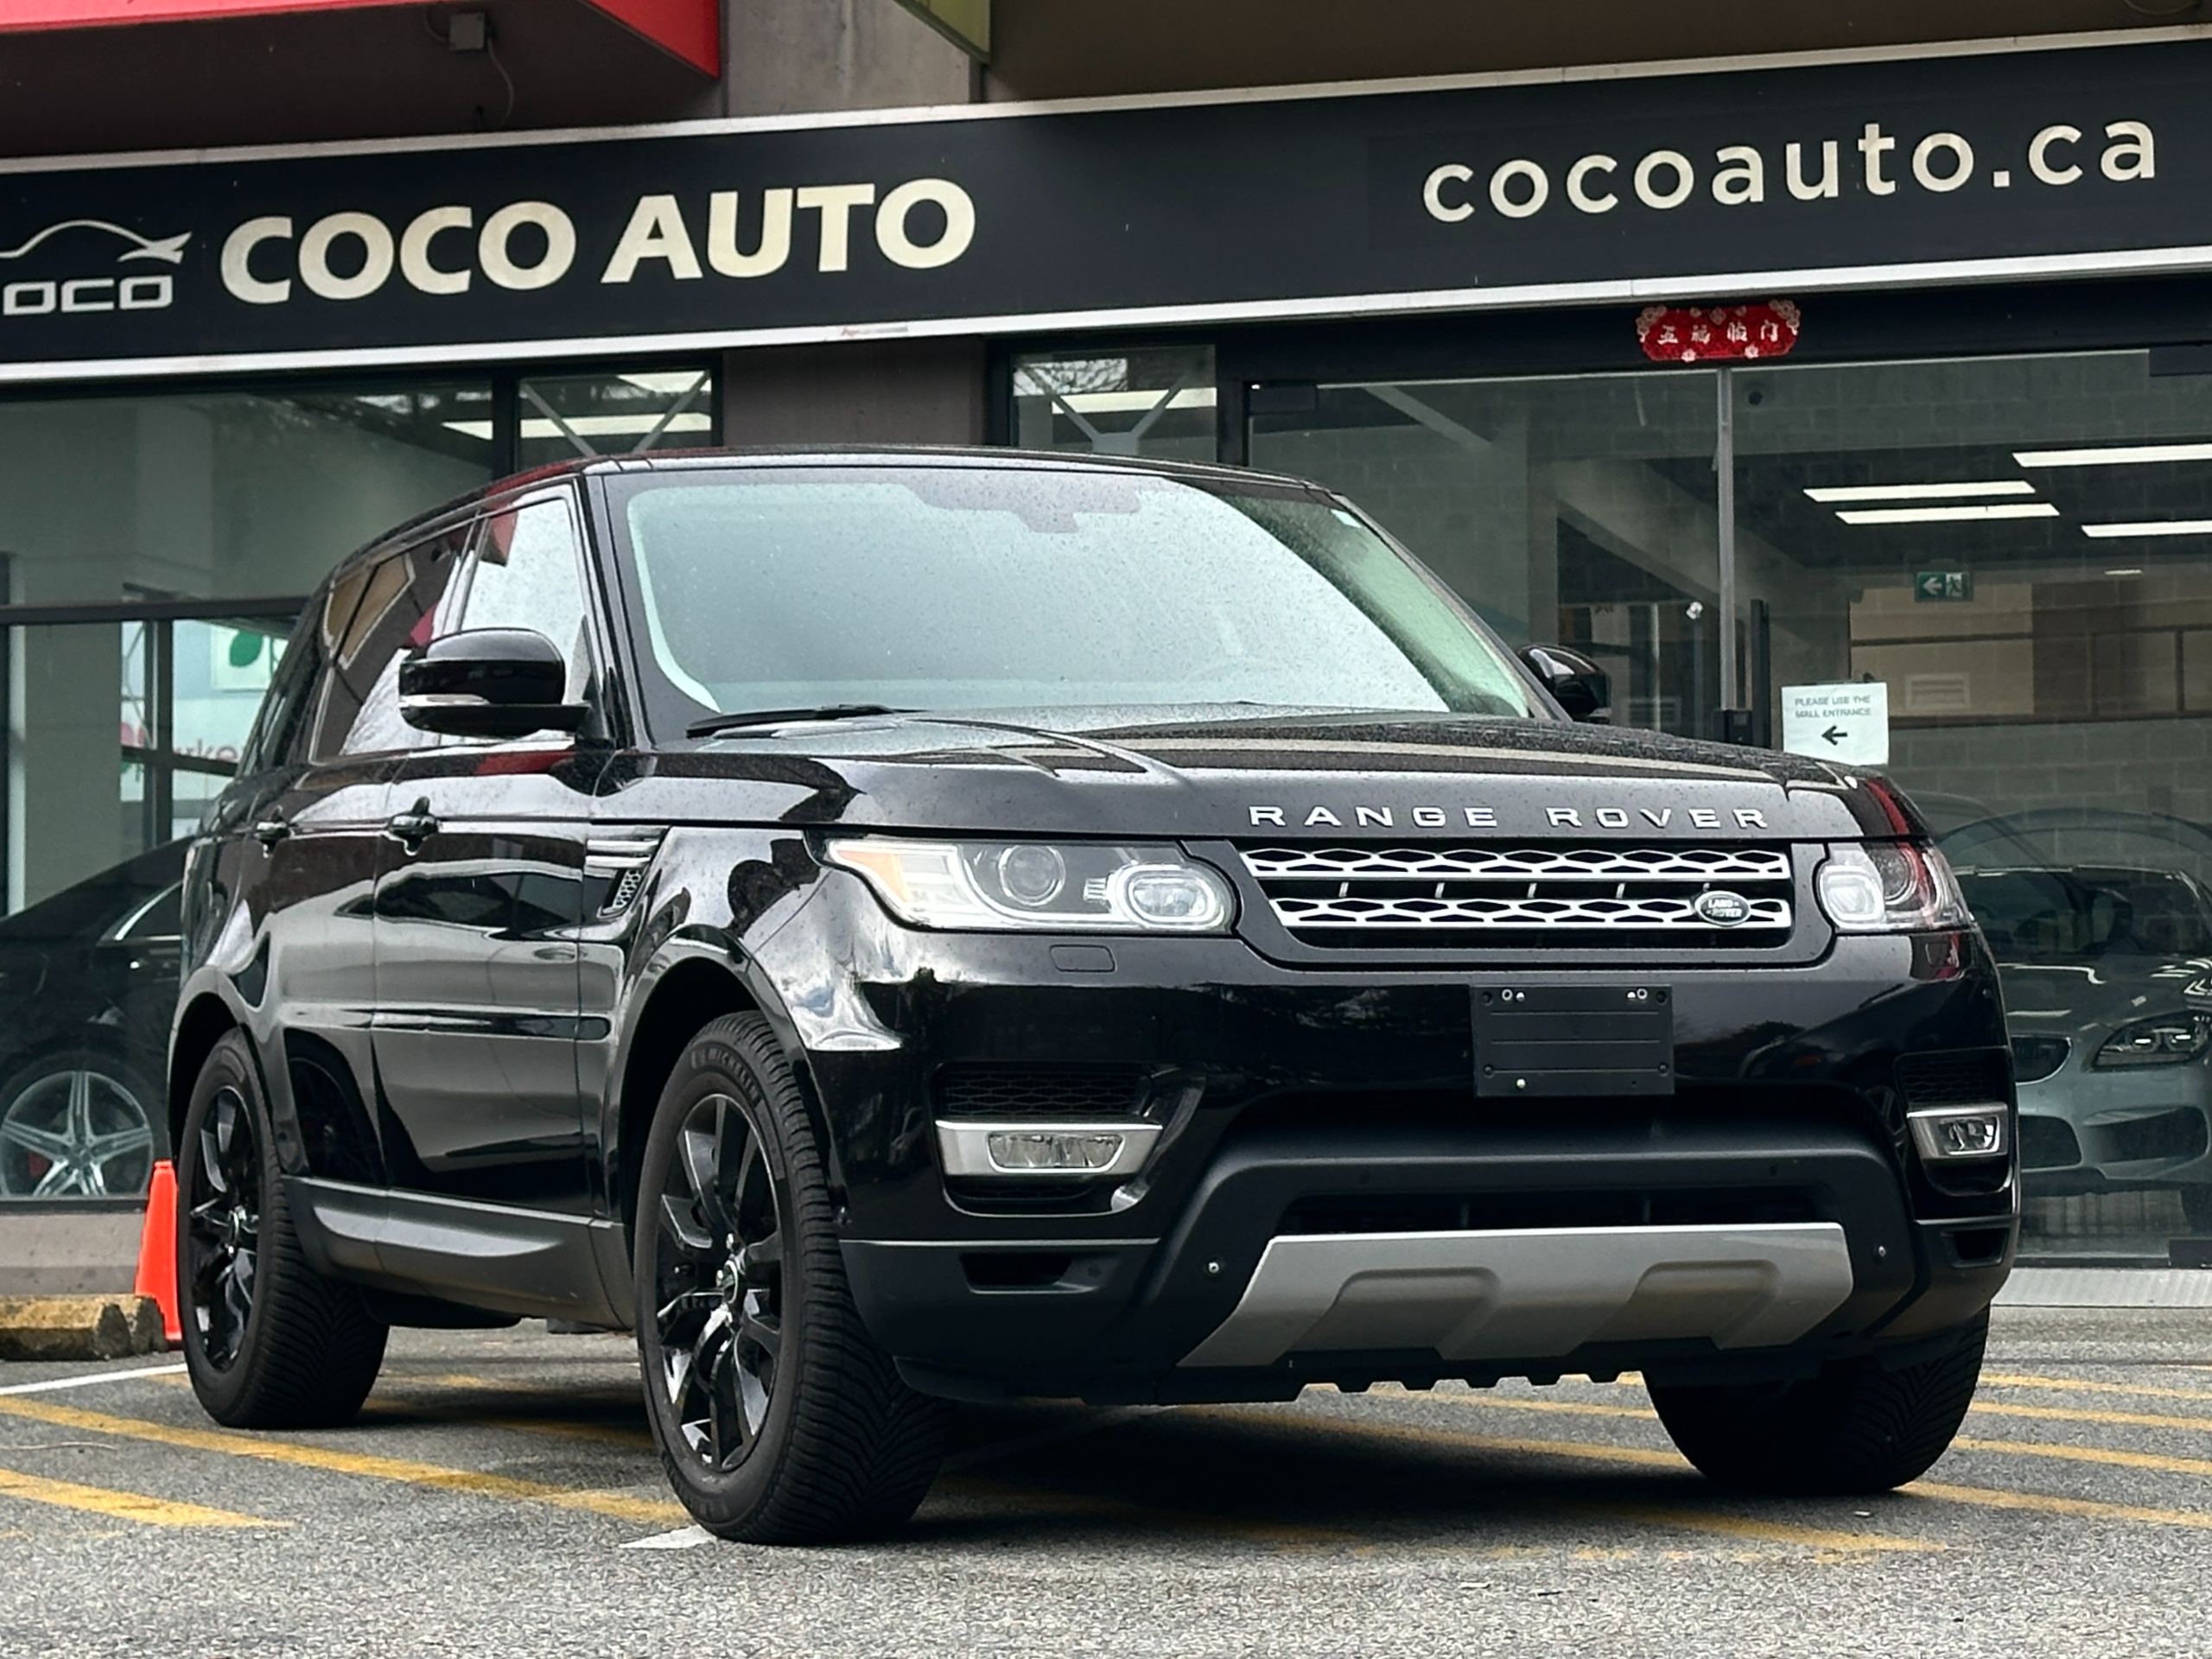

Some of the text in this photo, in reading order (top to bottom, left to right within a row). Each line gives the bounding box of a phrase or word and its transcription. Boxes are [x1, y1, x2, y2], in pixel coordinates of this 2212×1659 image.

[1422, 121, 2156, 222] cocoauto.ca
[220, 177, 976, 305] COCO AUTO
[1795, 695, 1871, 707] PLEASE USE THE
[1822, 707, 1872, 718] ENTRANCE
[1248, 805, 1769, 830] RANGE ROVER
